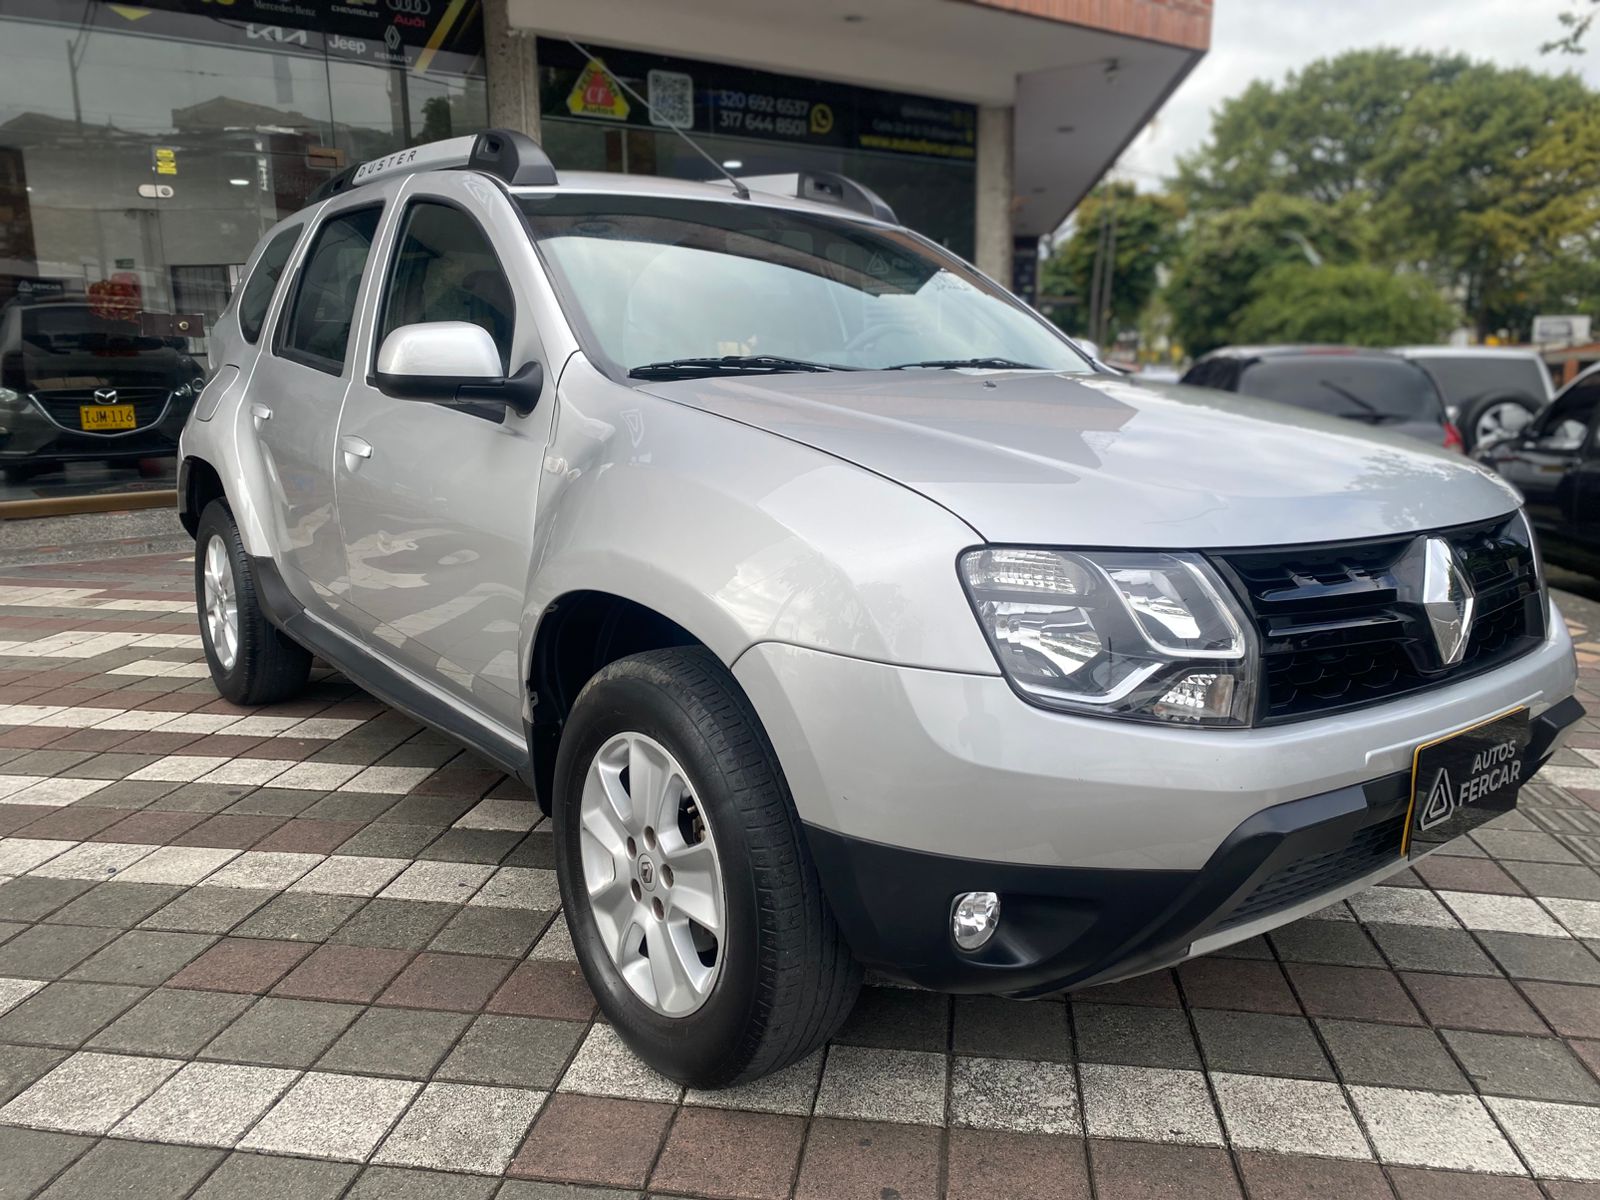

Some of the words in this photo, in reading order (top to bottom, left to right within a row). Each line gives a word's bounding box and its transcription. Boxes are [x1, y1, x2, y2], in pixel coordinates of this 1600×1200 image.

[331, 5, 379, 18] CHEVROLET
[394, 15, 425, 28] Audi
[247, 24, 307, 45] KIA
[329, 34, 366, 54] Jeep
[374, 51, 412, 63] RENAULT
[719, 89, 746, 108] 320
[748, 93, 775, 113] 692
[719, 109, 743, 128] 317
[745, 112, 774, 132] 644
[358, 150, 417, 177] DUSTER
[1472, 740, 1517, 775] AUTOS
[1459, 760, 1522, 807] FERCAR
